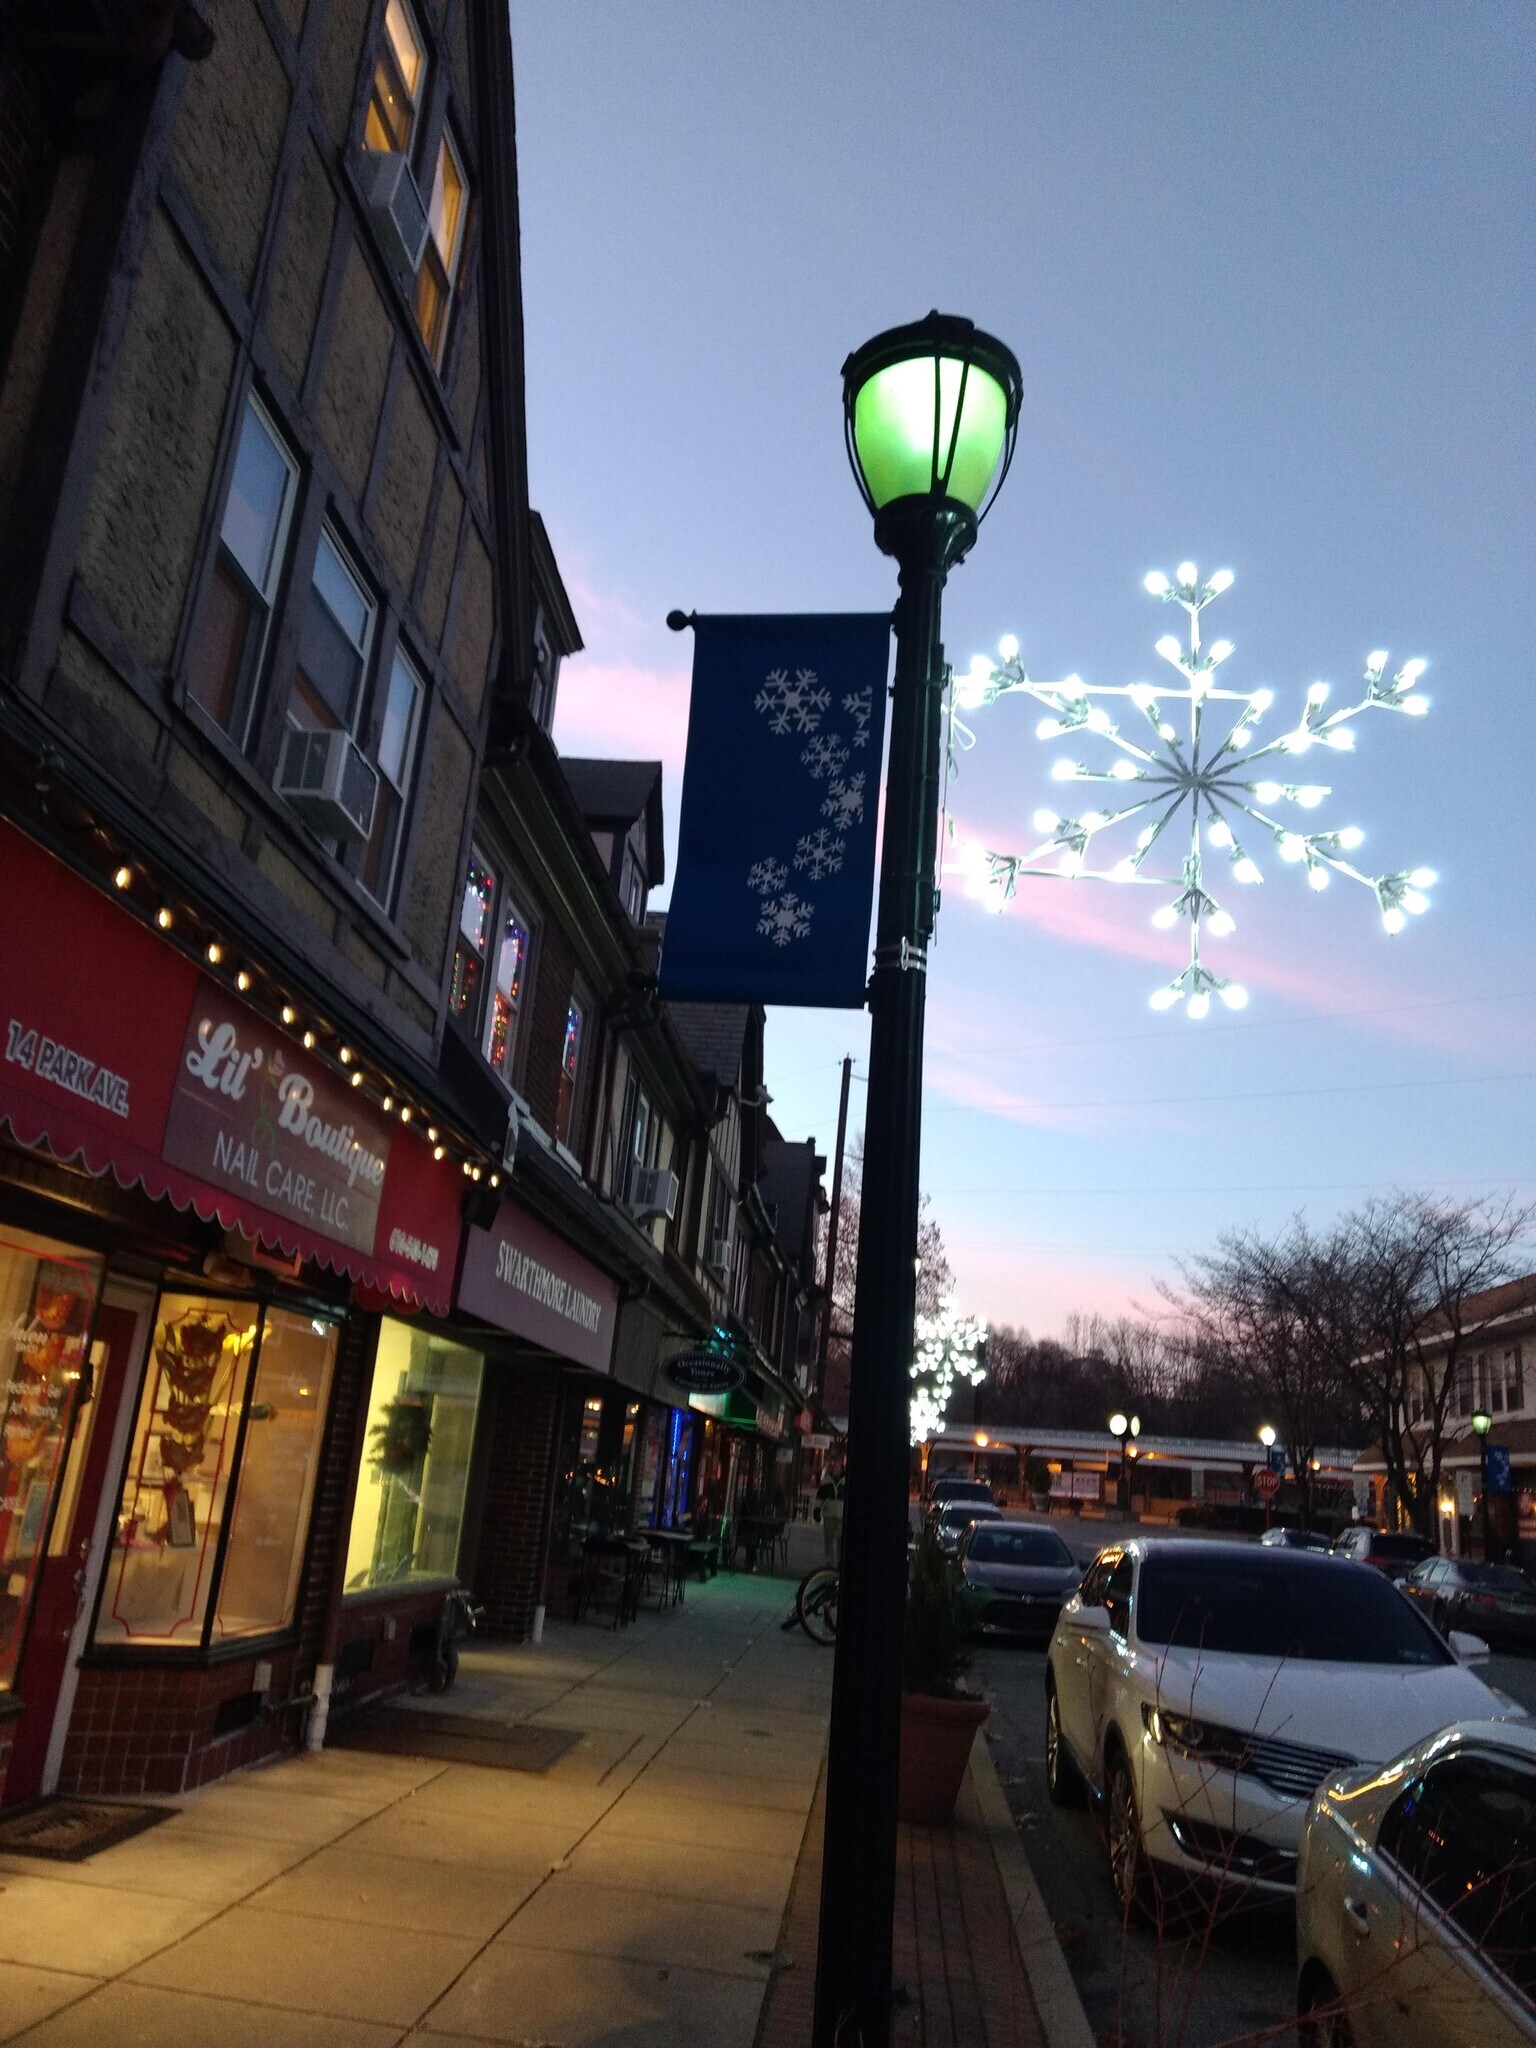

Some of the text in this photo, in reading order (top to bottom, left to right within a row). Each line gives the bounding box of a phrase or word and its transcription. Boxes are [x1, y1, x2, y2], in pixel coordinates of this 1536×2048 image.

[5, 1019, 38, 1071] 14
[35, 1036, 96, 1098] PARK
[278, 1073, 386, 1186] Boutique
[212, 1130, 259, 1188] NAIL
[265, 1160, 317, 1220] CARE,
[495, 1239, 566, 1315] SWARTHMORE
[564, 1285, 602, 1334] LAUNDRY
[1256, 1475, 1278, 1488] STOP
